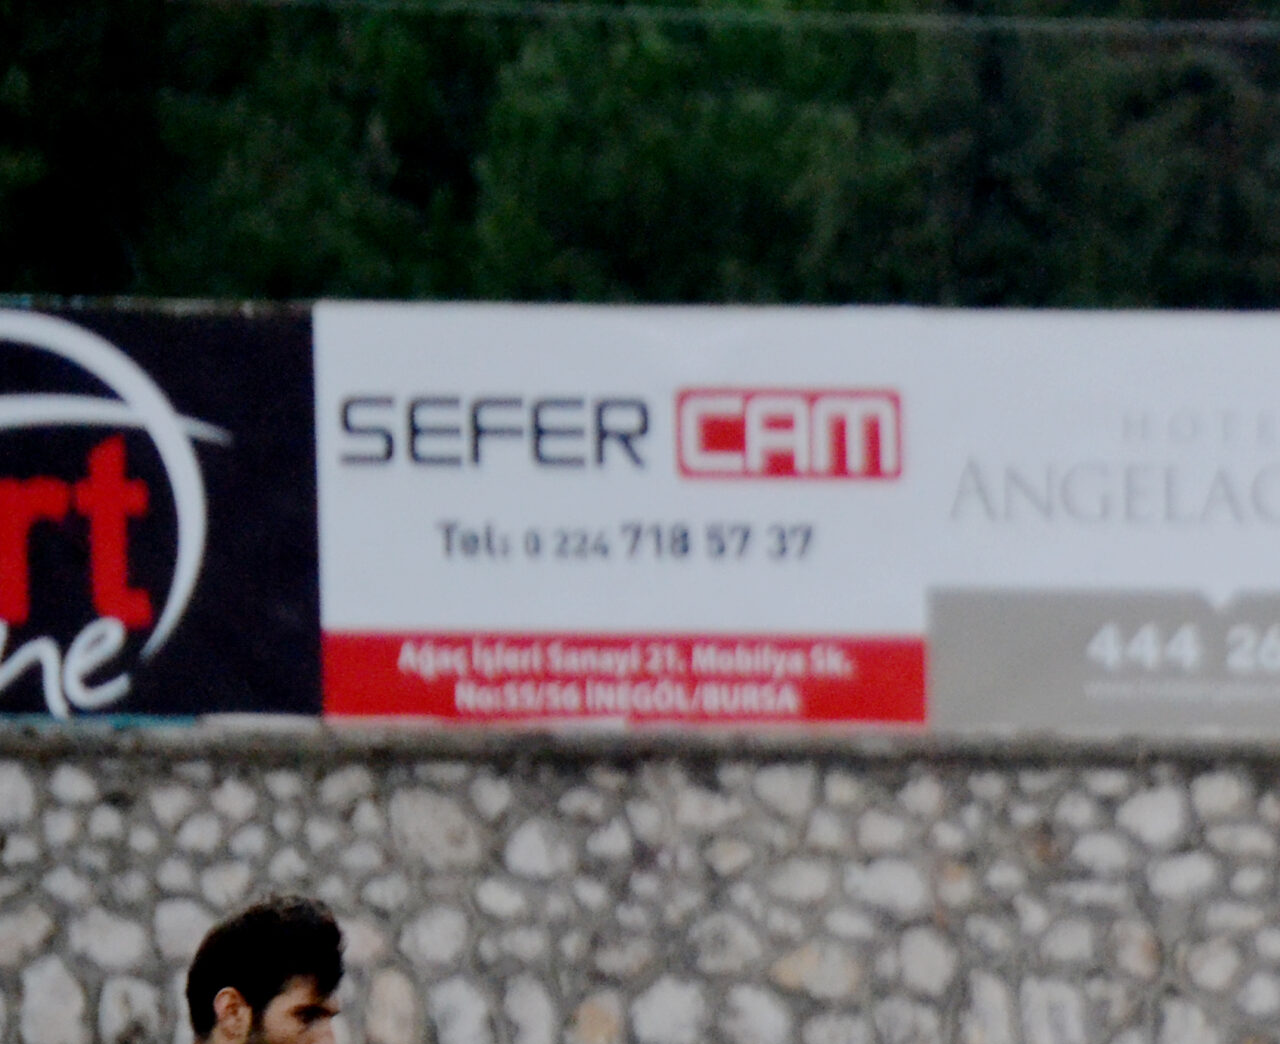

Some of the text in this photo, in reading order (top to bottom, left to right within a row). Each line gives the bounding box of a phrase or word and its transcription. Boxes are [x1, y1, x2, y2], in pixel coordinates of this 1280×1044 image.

[340, 393, 901, 476] SEFER CAM
[554, 528, 610, 558] 224
[619, 523, 692, 558] 718
[705, 525, 752, 558] 57
[766, 526, 814, 558] 37
[1087, 623, 1200, 669] 444
